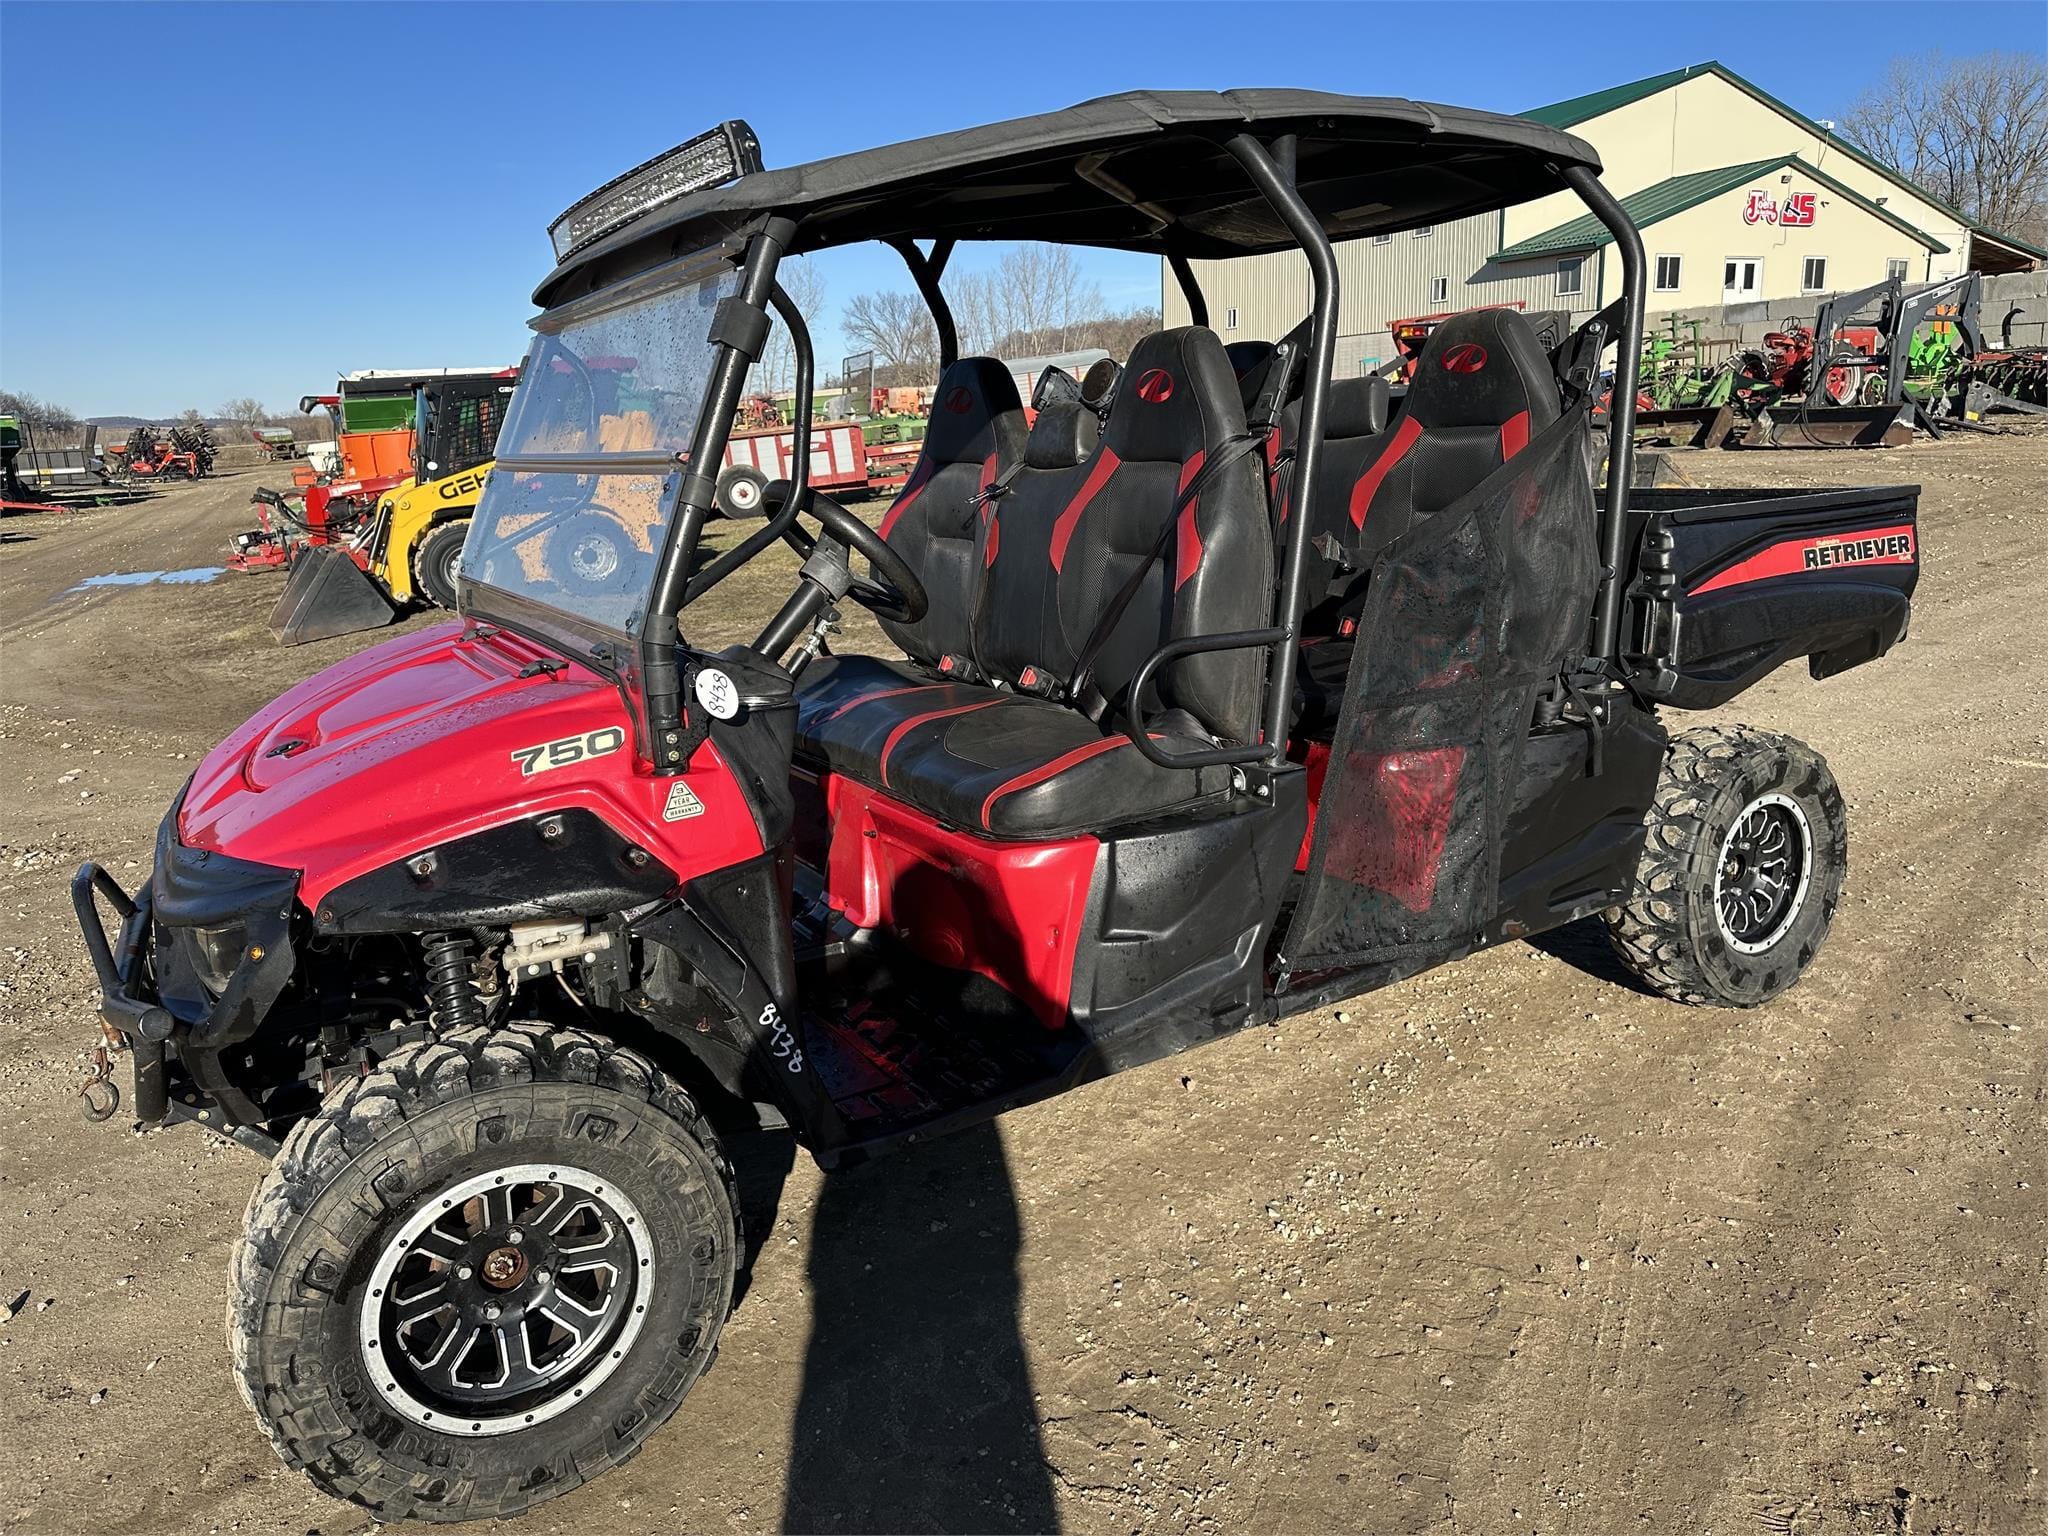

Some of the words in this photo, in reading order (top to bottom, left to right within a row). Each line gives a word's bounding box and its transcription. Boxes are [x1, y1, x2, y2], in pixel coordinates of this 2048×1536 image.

[439, 469, 487, 499] GEH
[1804, 534, 1911, 569] RETRIEVER
[708, 673, 729, 714] 8438
[512, 726, 624, 776] 750
[669, 806, 698, 817] WARRANTY
[673, 797, 690, 805] YEAR
[759, 1002, 803, 1073] 8438
